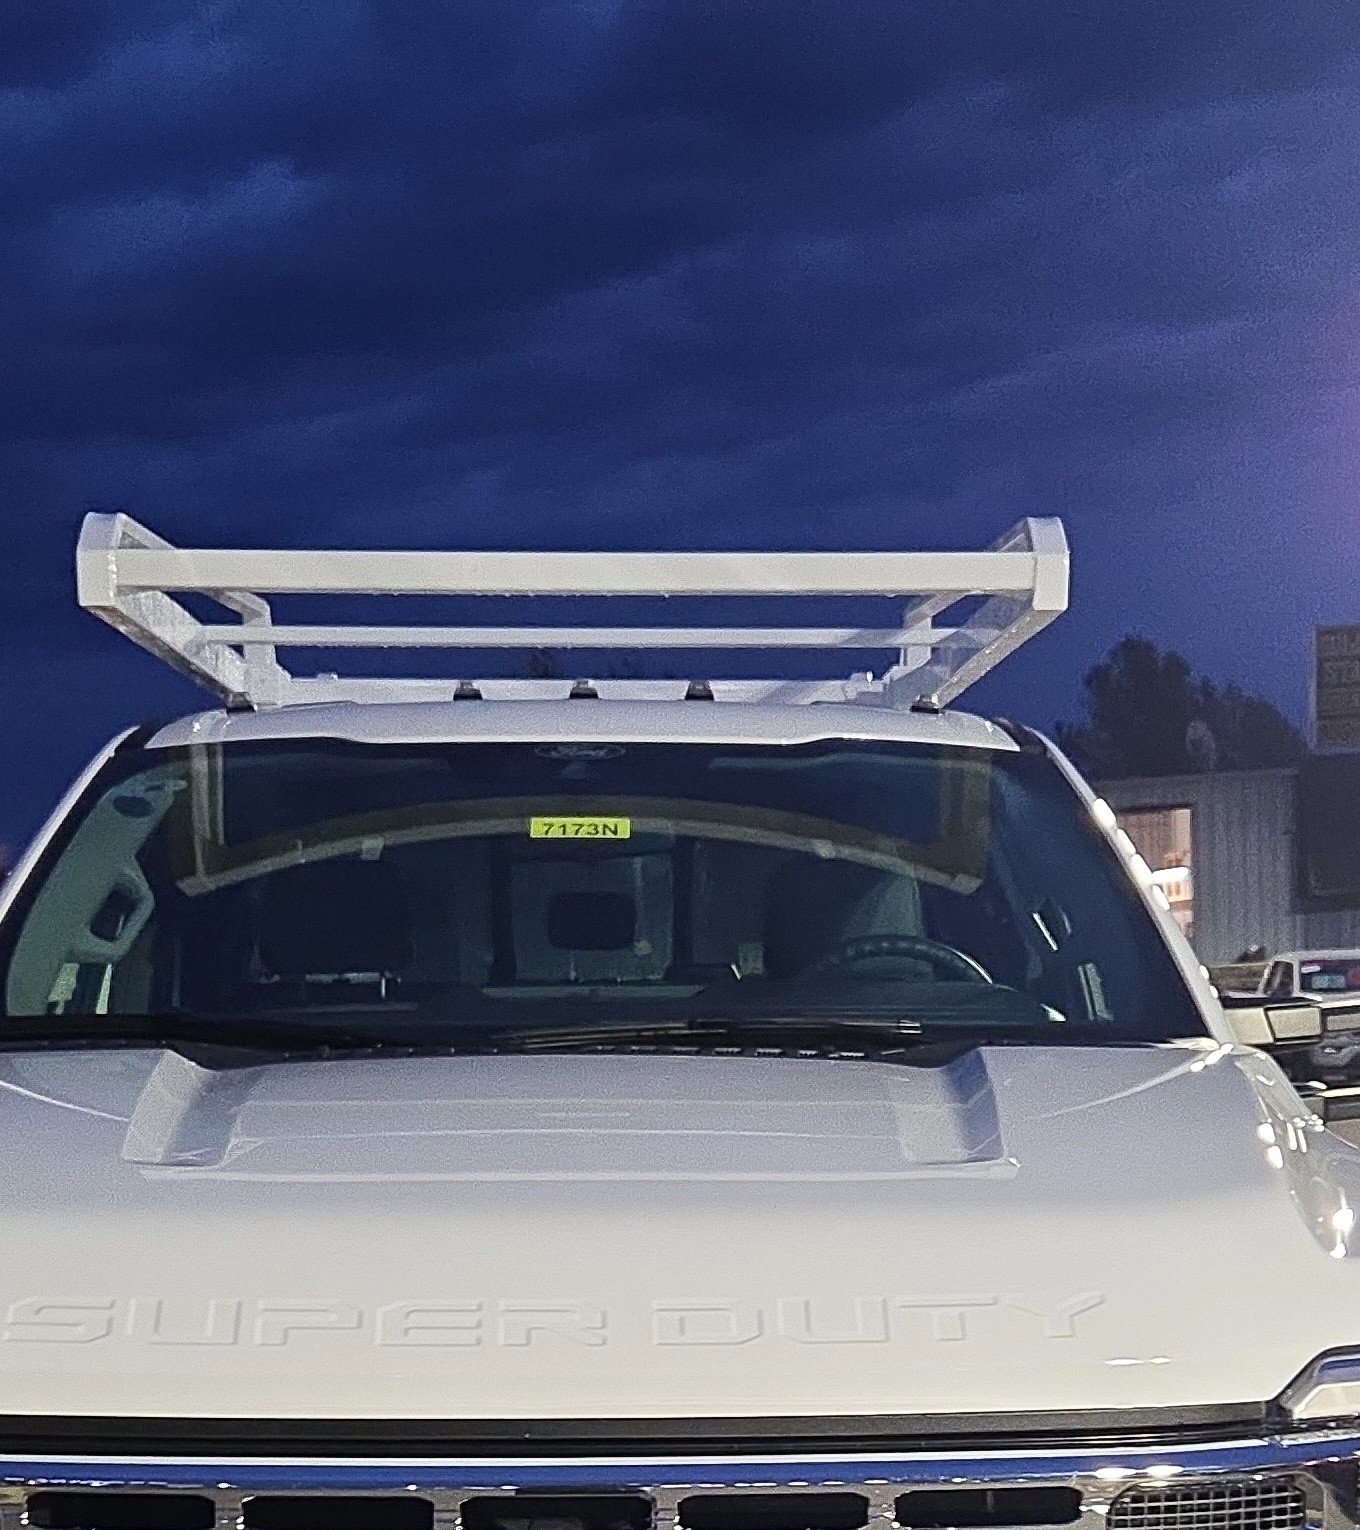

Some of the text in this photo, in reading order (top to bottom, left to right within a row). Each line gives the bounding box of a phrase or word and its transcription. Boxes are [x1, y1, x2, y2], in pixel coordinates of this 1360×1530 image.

[542, 823, 619, 836] 7173N
[3, 1292, 1106, 1347] SUPER DUTY
